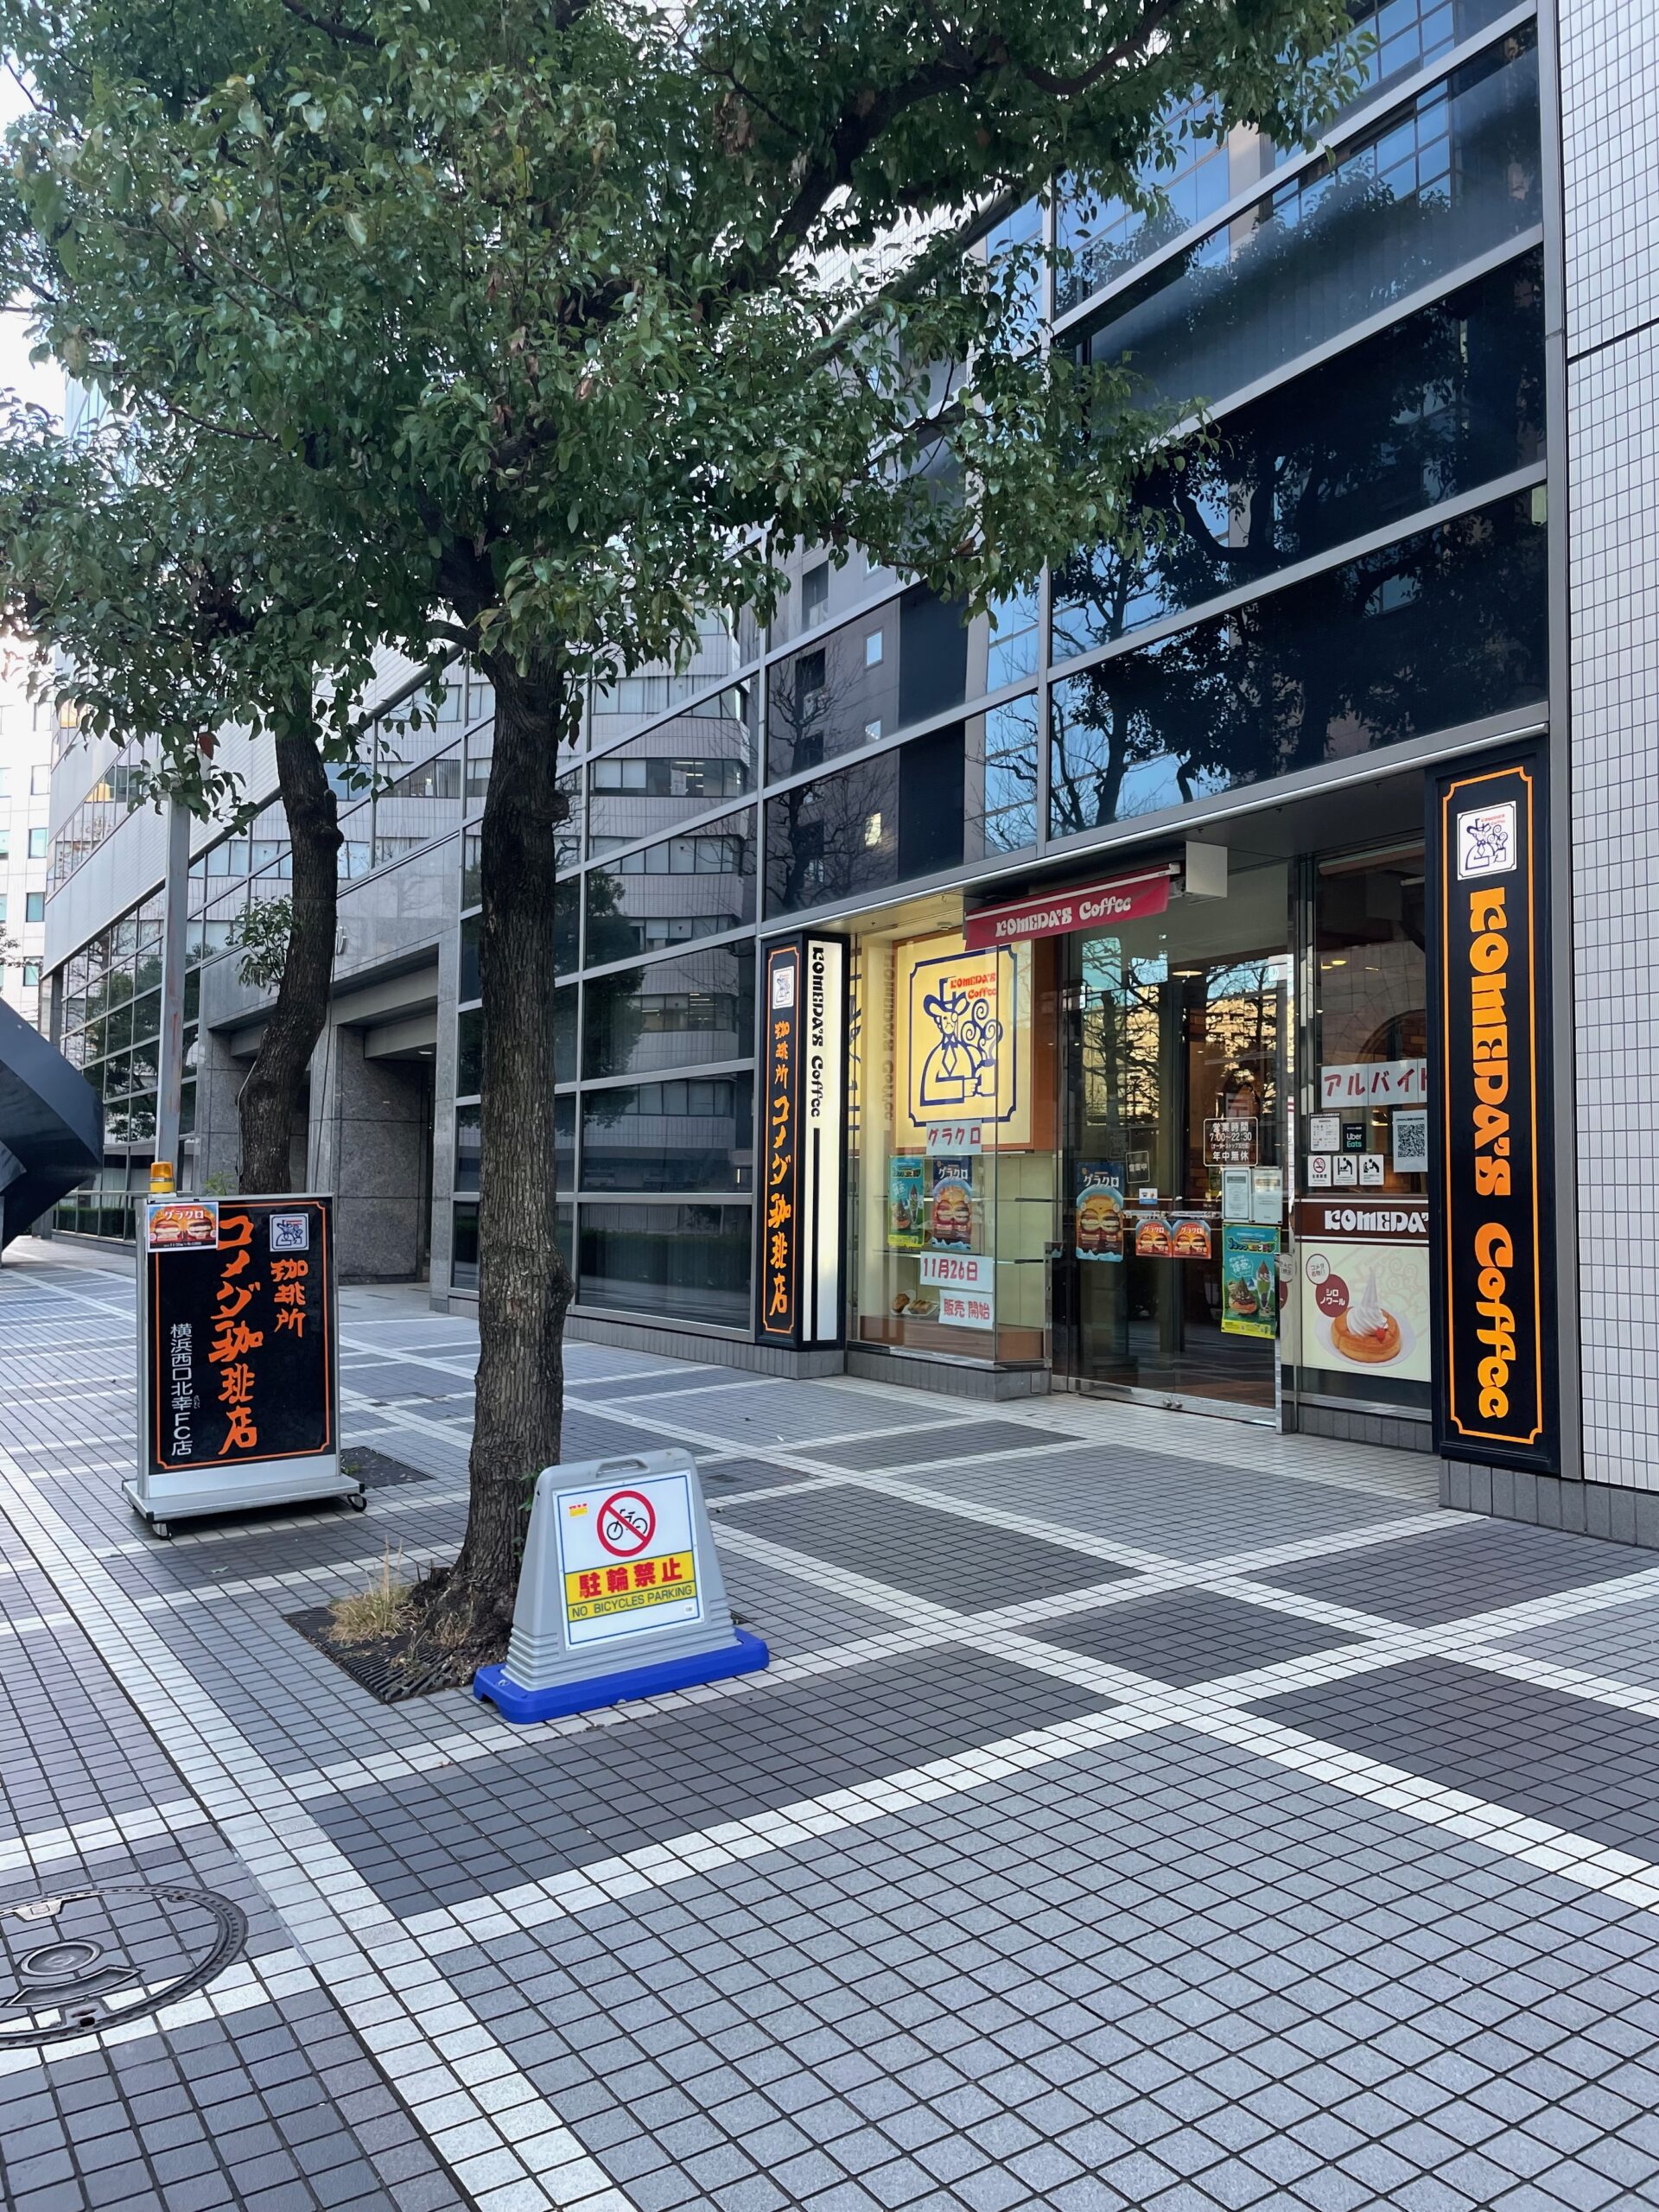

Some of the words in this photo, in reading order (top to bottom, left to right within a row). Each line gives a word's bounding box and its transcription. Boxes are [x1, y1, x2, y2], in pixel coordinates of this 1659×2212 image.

[995, 907, 1072, 938] KOMEDA'S
[1078, 895, 1132, 920] Coffee
[950, 973, 996, 989] KOMEDA'S
[968, 988, 997, 1000] Coffee
[811, 946, 825, 1047] KOMEDA'S
[1468, 887, 1510, 1198] KOMEDA'S
[810, 1055, 823, 1118] Coffee
[928, 1127, 982, 1147] グラクロ
[1212, 1151, 1249, 1161] 年中無休
[938, 1166, 968, 1180] グラクロ
[1084, 1173, 1120, 1188] グラクロ
[164, 1210, 204, 1220] グラクロ
[767, 1096, 792, 1316] コメダ珈琲店
[923, 1257, 978, 1281] 11月26日
[1319, 1297, 1345, 1306] ノワール
[1325, 1288, 1339, 1297] シロ
[1473, 1221, 1516, 1420] Coffee
[208, 1216, 264, 1455] コメダ珈琲店
[170, 1323, 193, 1456] 横浜西口北幸FC店
[579, 1558, 683, 1599] 駐輪禁止
[572, 1605, 588, 1618] NO
[594, 1594, 645, 1614] BICYCLES
[647, 1585, 692, 1604] PARKING
